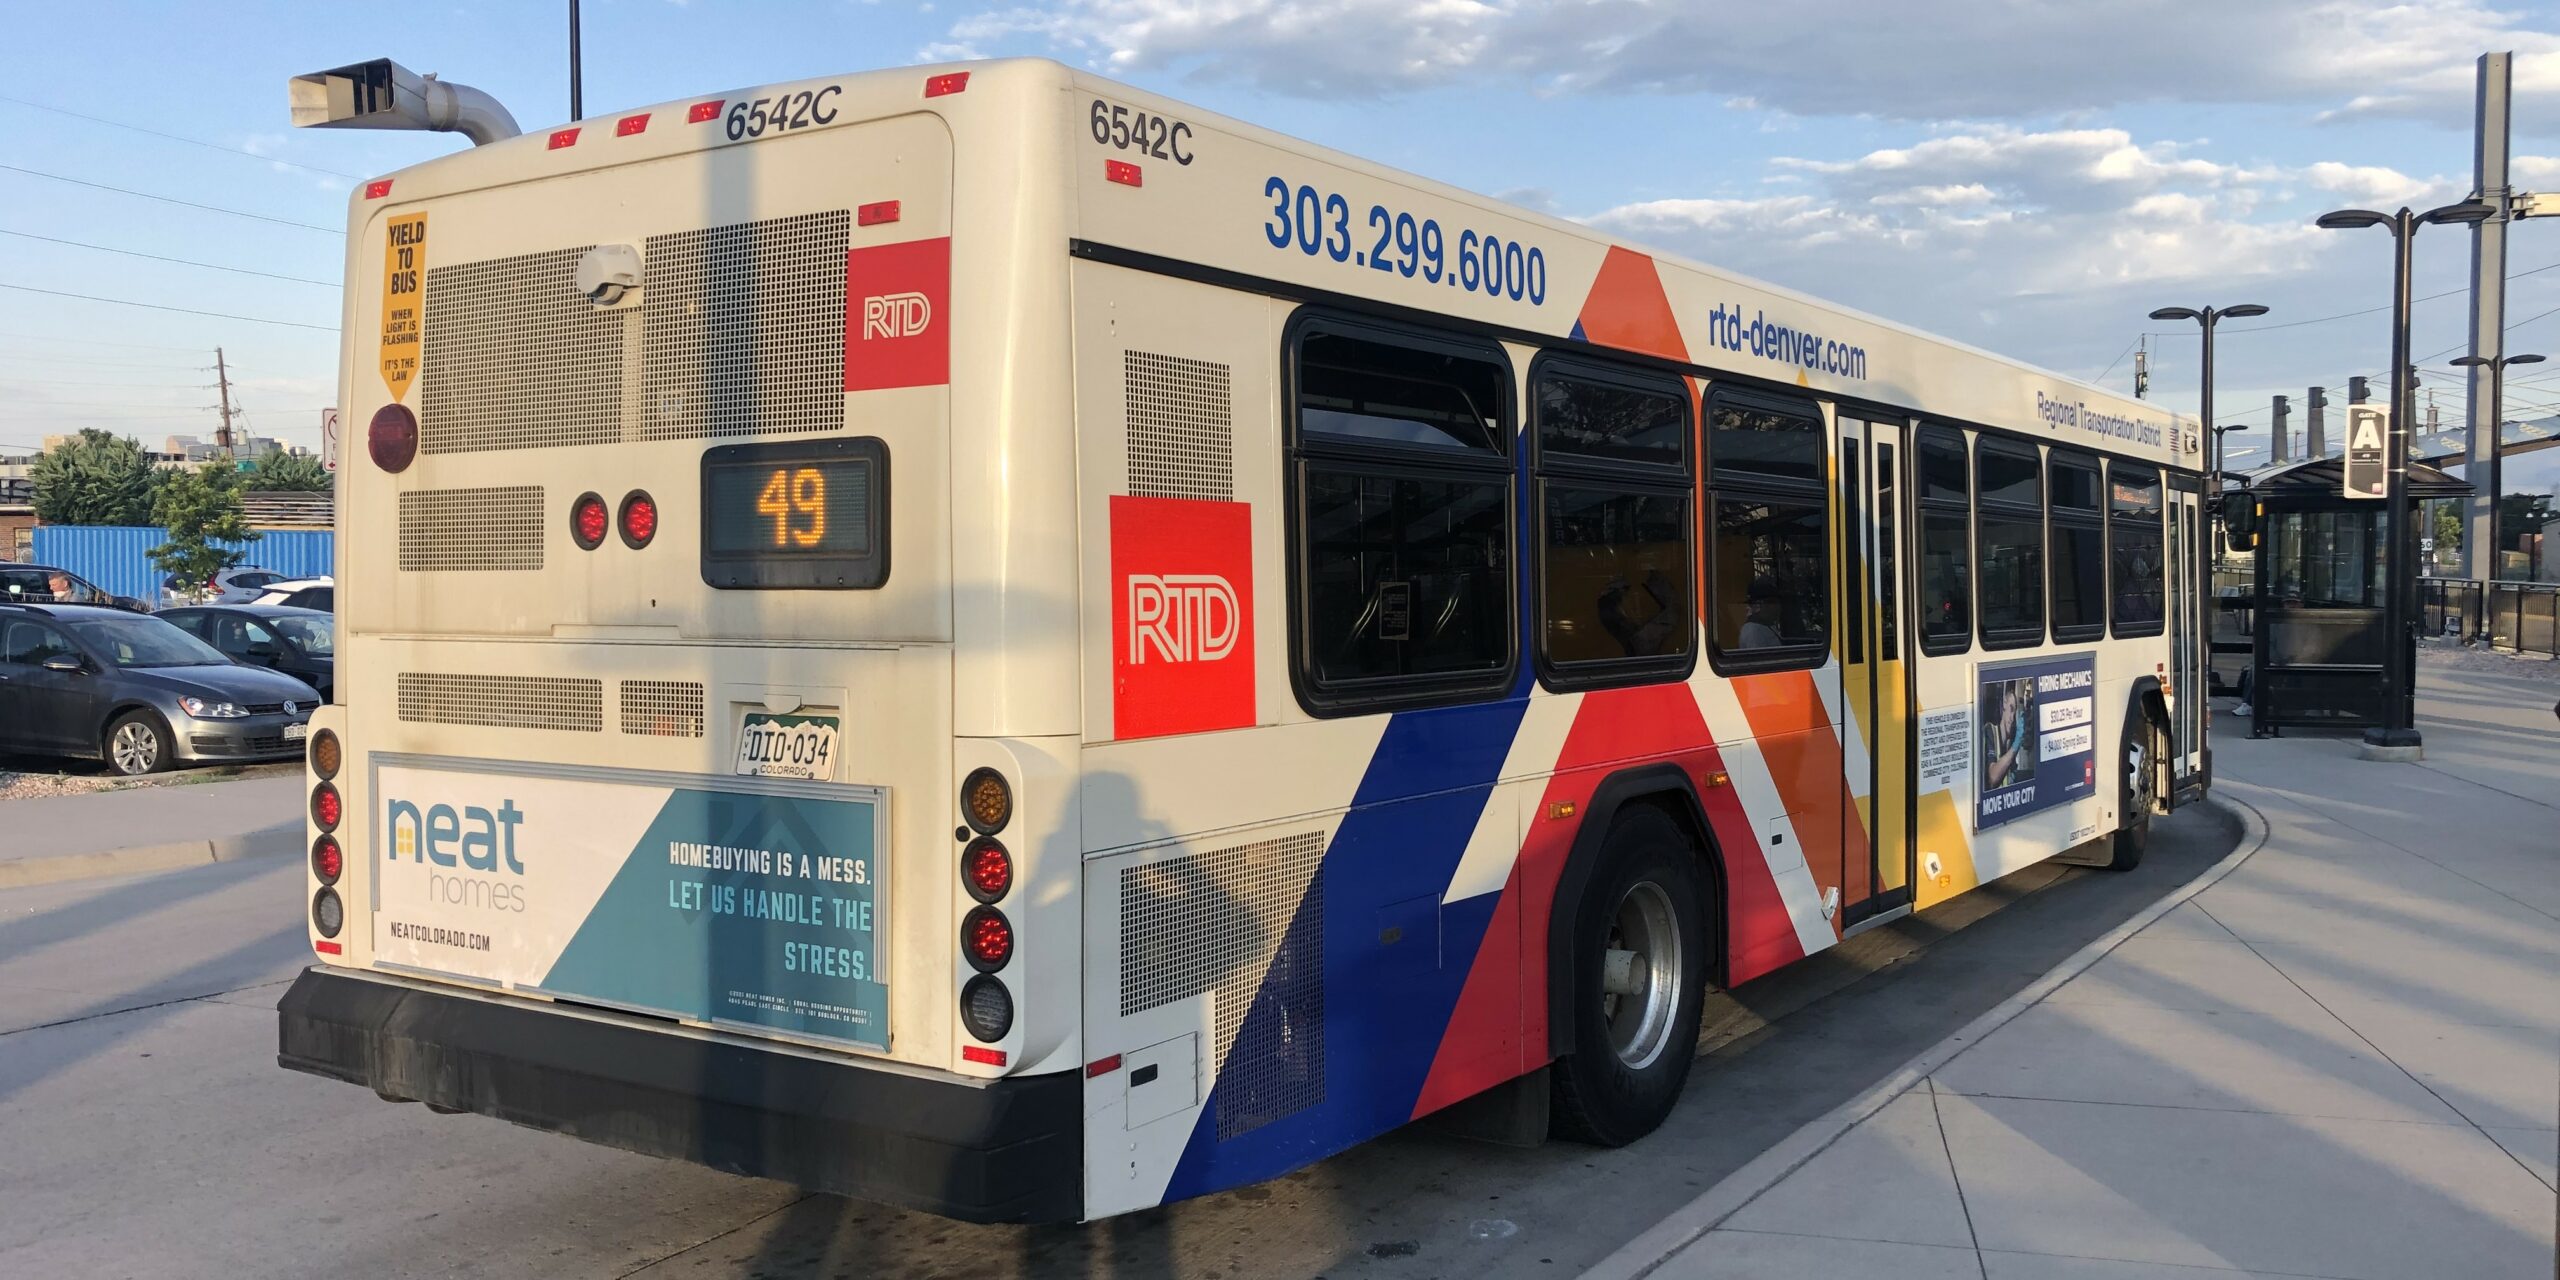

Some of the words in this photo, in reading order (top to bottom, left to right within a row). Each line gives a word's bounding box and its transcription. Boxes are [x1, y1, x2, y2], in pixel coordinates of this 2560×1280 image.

[726, 85, 842, 141] 6542C
[1091, 99, 1194, 165] 6542C
[389, 221, 425, 247] YIELD
[1264, 176, 1546, 305] 303.299.6000
[397, 247, 413, 270] TO
[391, 270, 417, 295] BUS
[386, 321, 407, 334] LIGHT
[408, 320, 416, 331] IS
[391, 308, 413, 321] WHEN
[863, 291, 931, 340] RTD
[383, 332, 419, 346] FLASHING
[1709, 303, 1867, 380] rtd-denver.com
[384, 359, 399, 371] IT'S
[400, 358, 415, 369] THE
[391, 370, 408, 382] LAW
[2037, 390, 2078, 429] Regional
[2079, 402, 2136, 441] Transportation
[2136, 418, 2162, 448] District
[2351, 419, 2382, 449] A
[758, 468, 825, 546] 49
[1128, 574, 1240, 665] RTD
[2038, 674, 2059, 693] HIRING
[2059, 670, 2092, 690] MECHANICS
[760, 765, 808, 776] COLORADO
[1982, 796, 2002, 816] MOVE
[2002, 790, 2021, 810] YOUR
[2021, 786, 2036, 804] CITY
[388, 799, 524, 876] neat
[669, 841, 771, 875] HOMEBUYING
[777, 852, 793, 877] IS
[799, 854, 811, 879] A
[818, 855, 871, 885] MESS.
[430, 867, 525, 913] homes
[669, 879, 704, 911] LET
[711, 884, 735, 915] US
[743, 888, 823, 926] HANDLE
[832, 897, 872, 932] THE
[390, 921, 490, 952] NEATCOLORADO.COM
[784, 941, 872, 982] STRESS.
